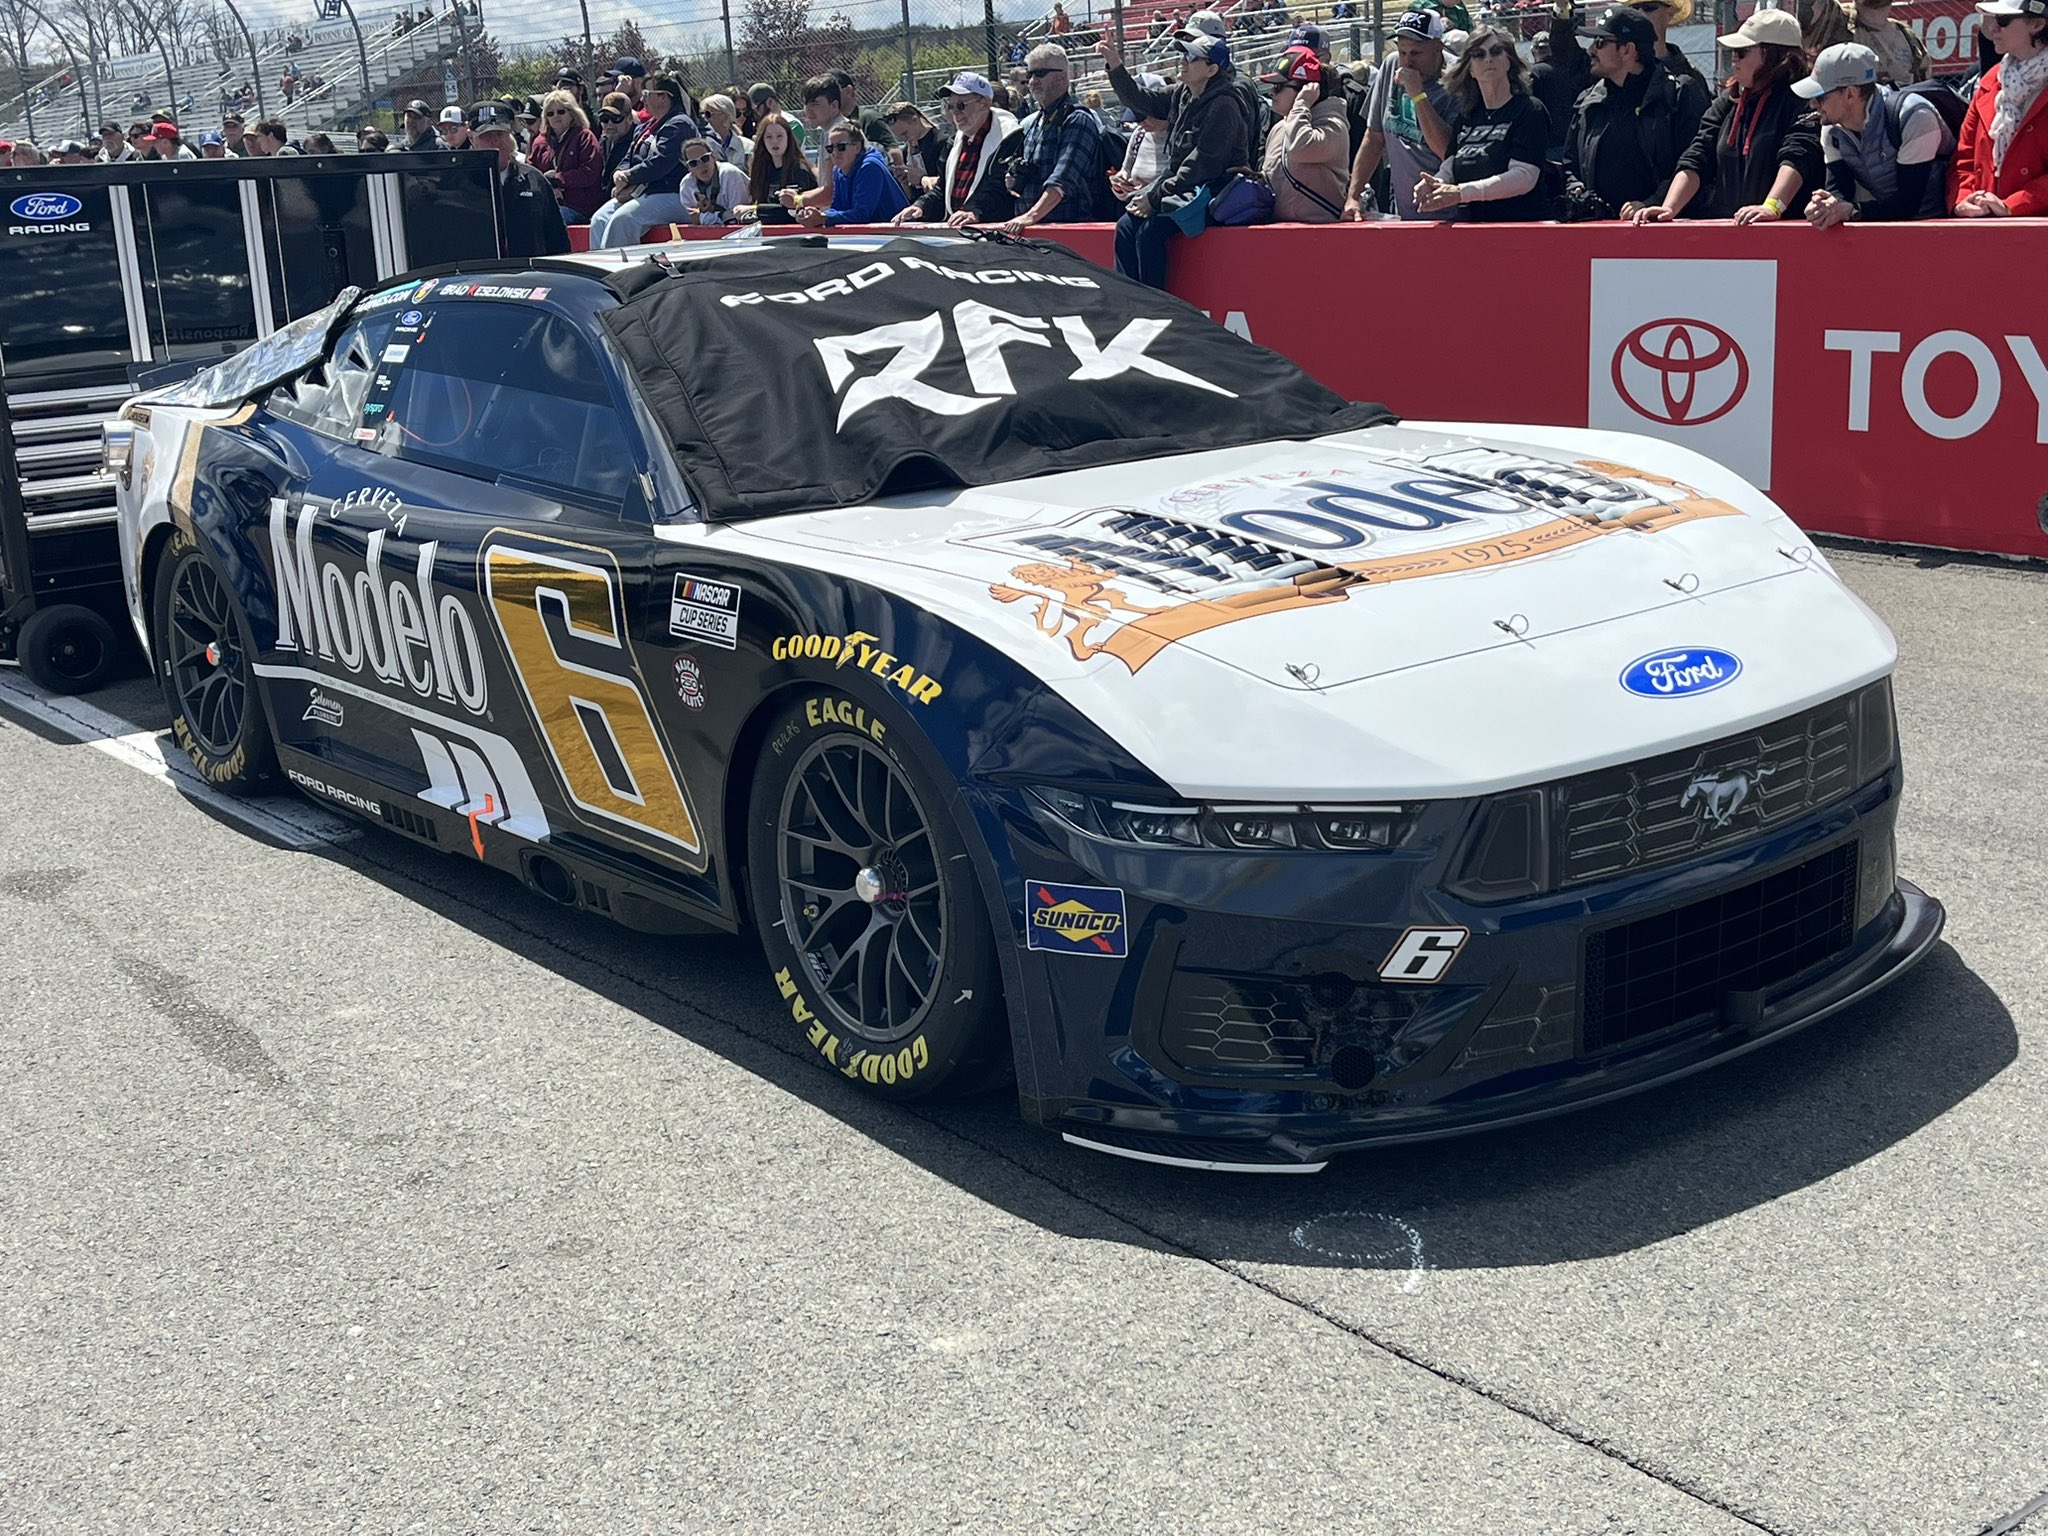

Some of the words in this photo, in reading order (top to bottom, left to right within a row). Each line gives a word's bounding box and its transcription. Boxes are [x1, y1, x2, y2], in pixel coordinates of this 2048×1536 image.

[25, 197, 68, 215] Ford
[8, 222, 90, 235] RACING
[440, 284, 465, 296] BRAD
[467, 285, 532, 299] KESELOWSKI
[719, 262, 896, 307] FORD
[899, 256, 1101, 288] RACING
[813, 299, 1240, 434] RFK
[1169, 468, 1358, 503] CERVEZA
[330, 487, 408, 537] CERVEZA
[1451, 540, 1532, 564] 1925
[269, 497, 488, 716] Modelo
[693, 582, 731, 607] NASCAR
[680, 607, 699, 627] CUP
[698, 611, 728, 633] SERIES
[675, 659, 701, 680] NASCAR
[1645, 654, 1723, 692] Ford
[485, 544, 700, 855] 6
[805, 697, 886, 746] EAGLE
[288, 769, 326, 794] FORD
[326, 784, 382, 816] RACING
[1035, 909, 1119, 931] SUNOCO
[1378, 926, 1469, 983] 6
